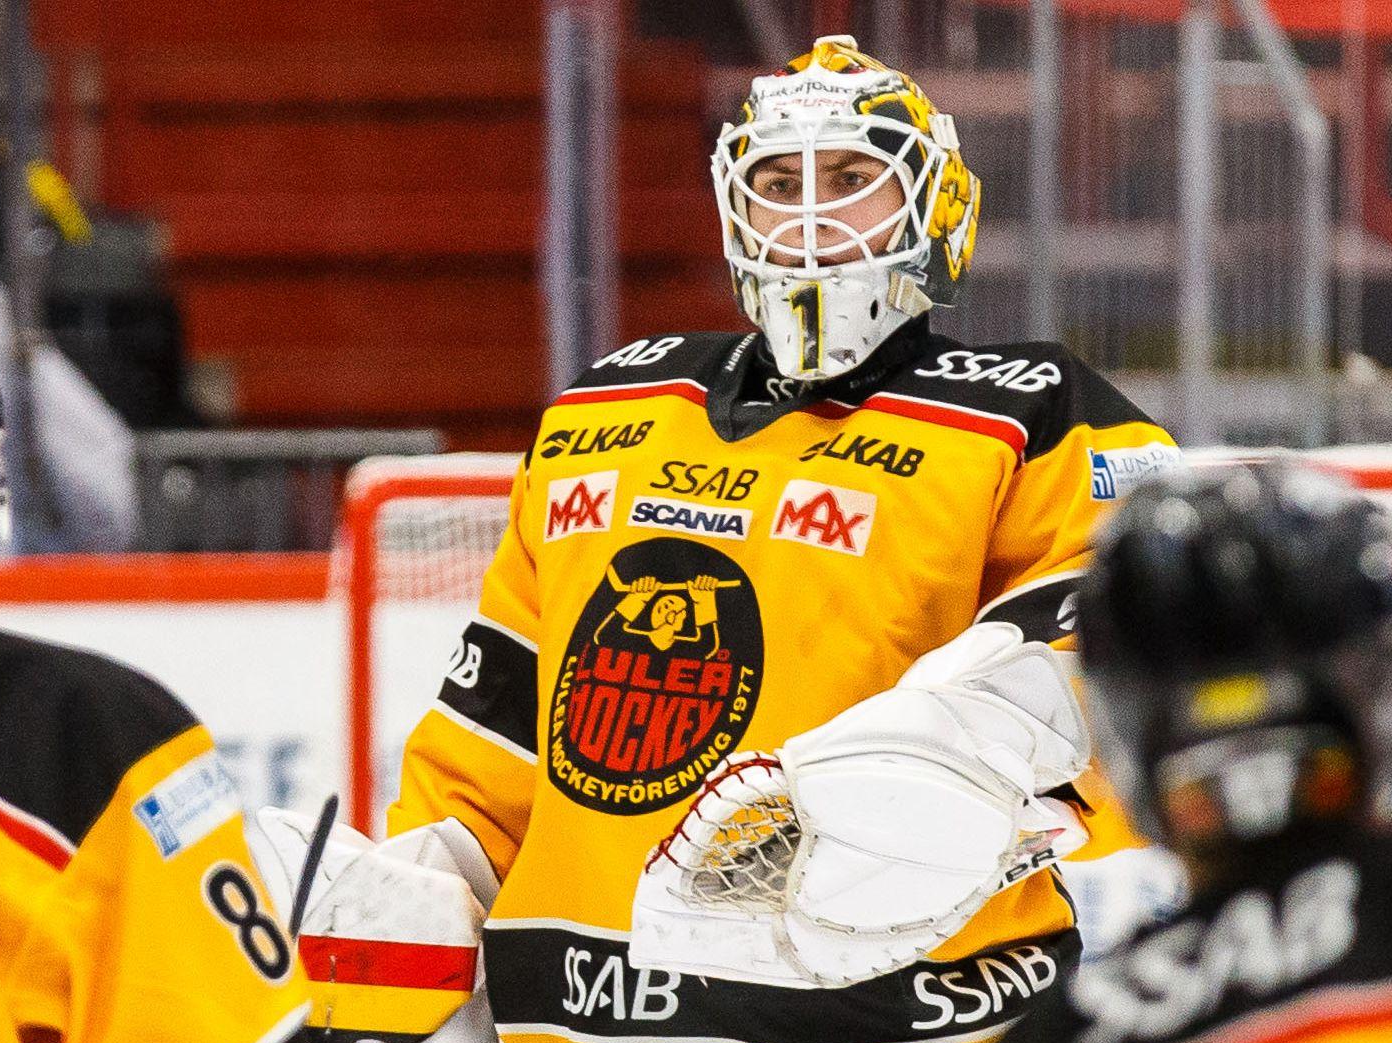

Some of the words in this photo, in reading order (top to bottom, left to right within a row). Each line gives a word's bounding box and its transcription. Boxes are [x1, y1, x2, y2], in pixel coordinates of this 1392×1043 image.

[788, 280, 823, 374] 1
[914, 350, 1062, 393] SSAB
[569, 420, 656, 456] LKAB
[823, 433, 925, 478] LKAB
[545, 479, 610, 540] MAX
[649, 460, 760, 502] SSAB
[631, 501, 745, 537] SCANIA
[773, 487, 867, 553] MAX
[574, 643, 734, 698] LULEÅ
[728, 664, 755, 724] 1977
[567, 681, 725, 775] HOCKEY
[561, 946, 683, 1022] SSAB
[911, 944, 1058, 1031] SSAB
